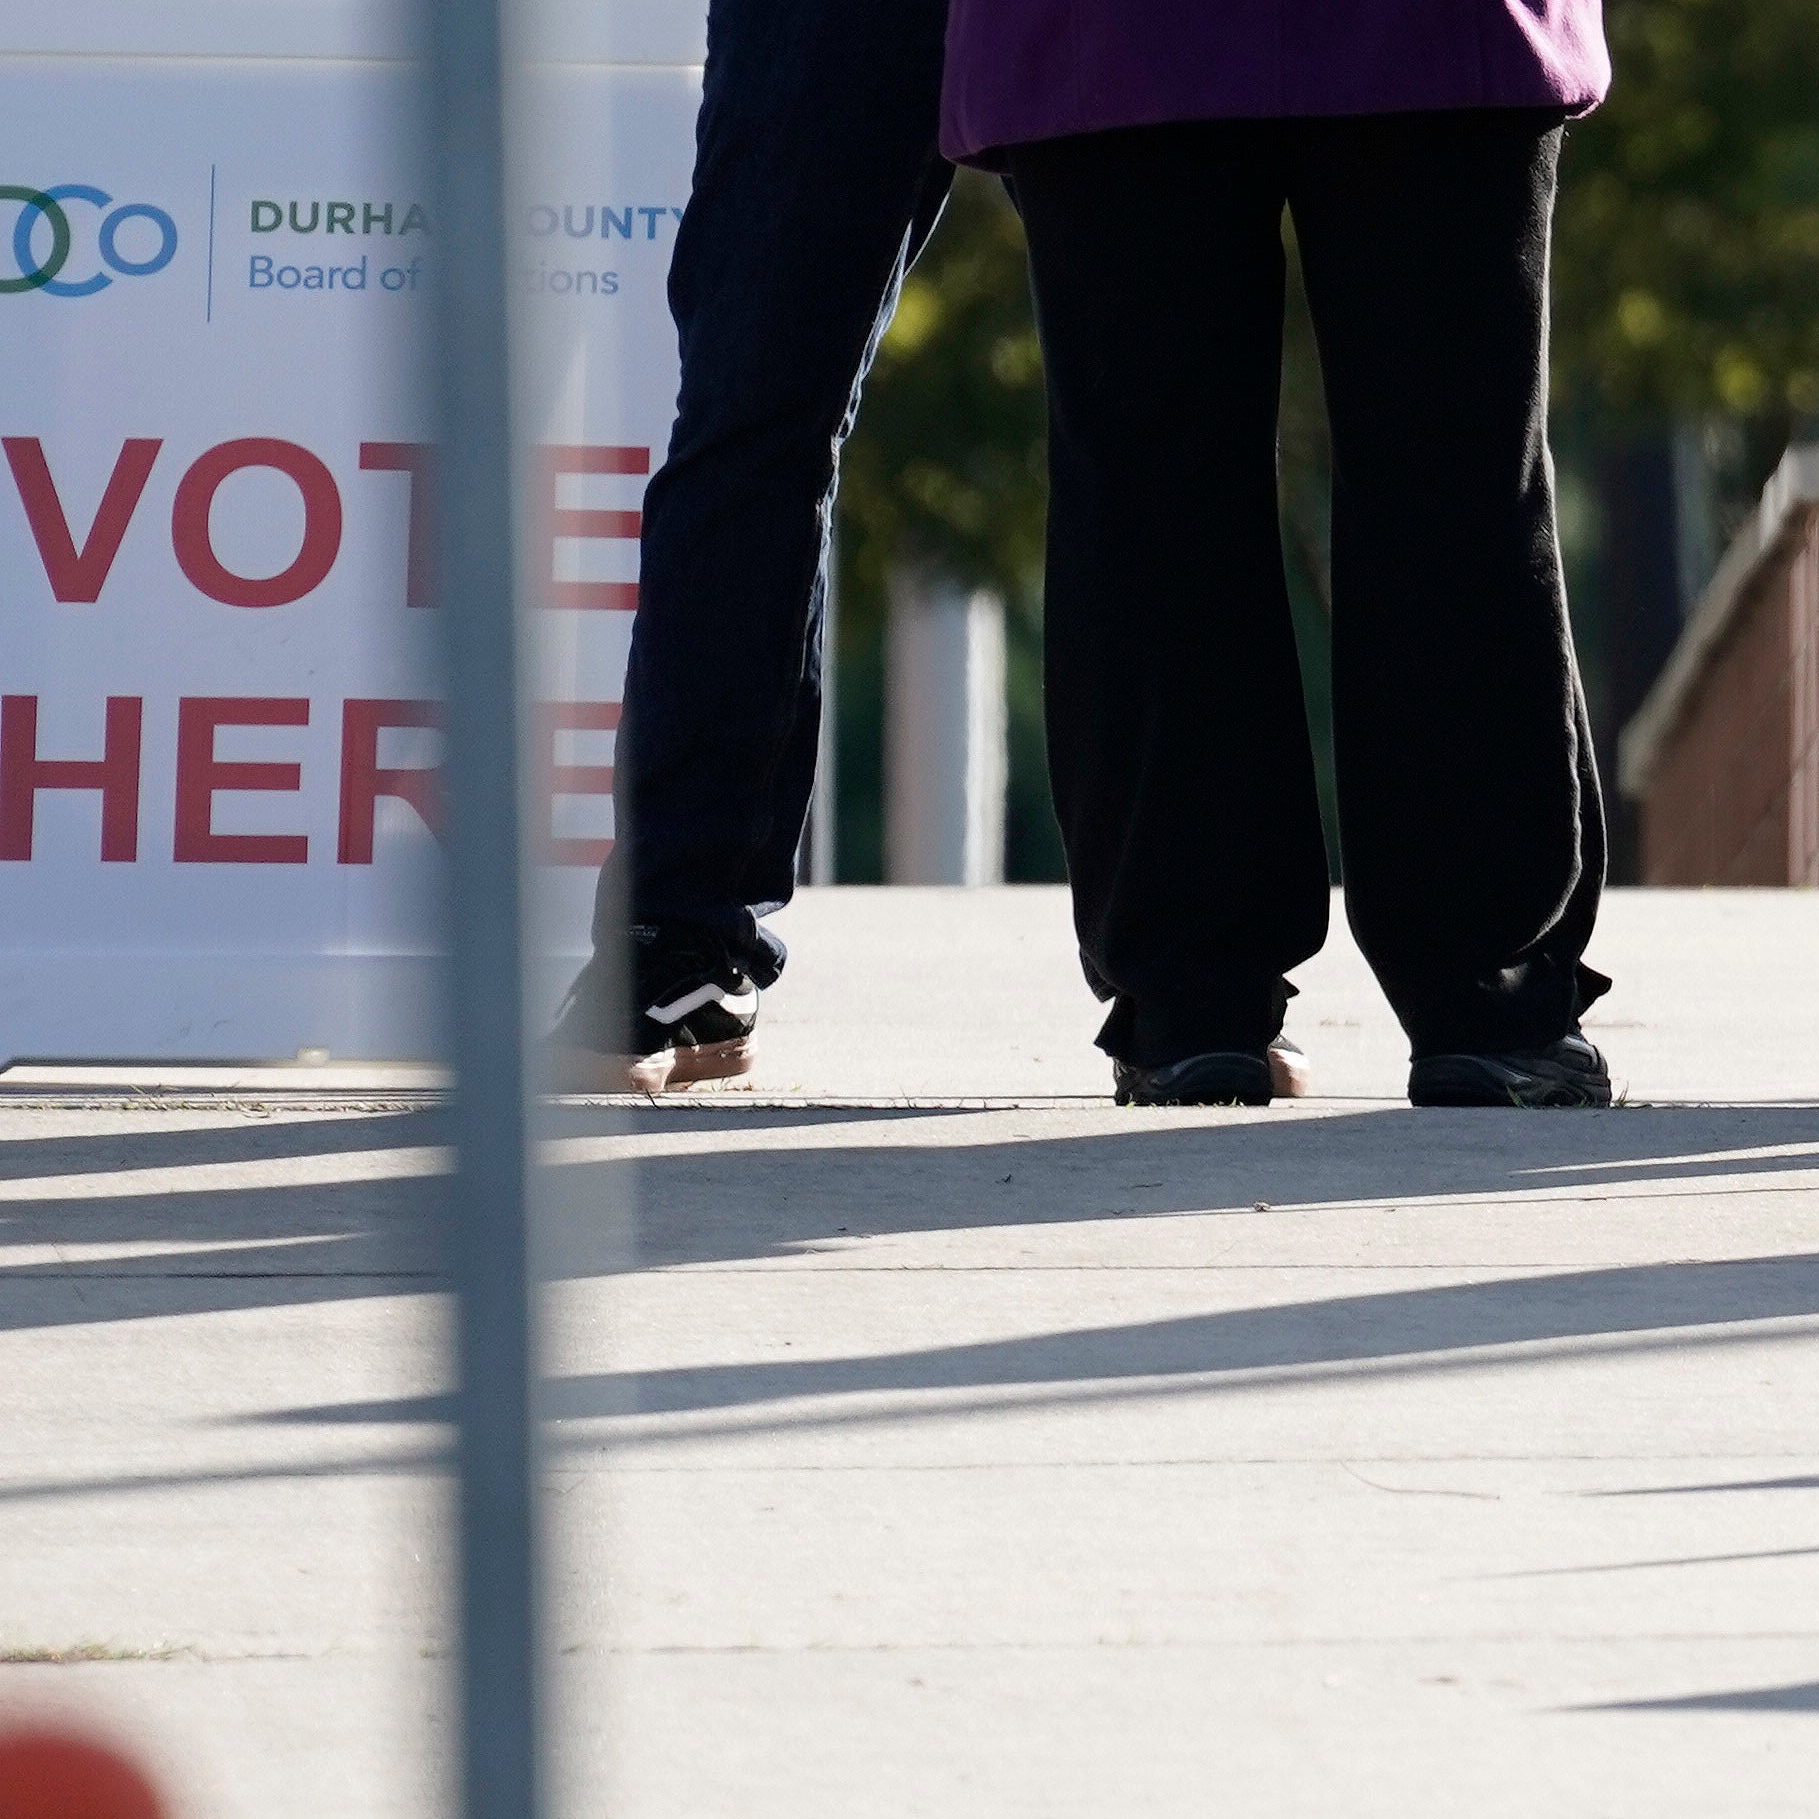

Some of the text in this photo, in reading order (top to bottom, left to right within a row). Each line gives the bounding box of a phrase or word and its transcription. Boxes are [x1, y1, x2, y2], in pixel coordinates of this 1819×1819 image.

[249, 254, 367, 291] Board
[380, 258, 424, 292] of
[250, 200, 688, 241] DURHA OUNT
[0, 436, 651, 610] VOTE
[0, 695, 620, 868] HERE
